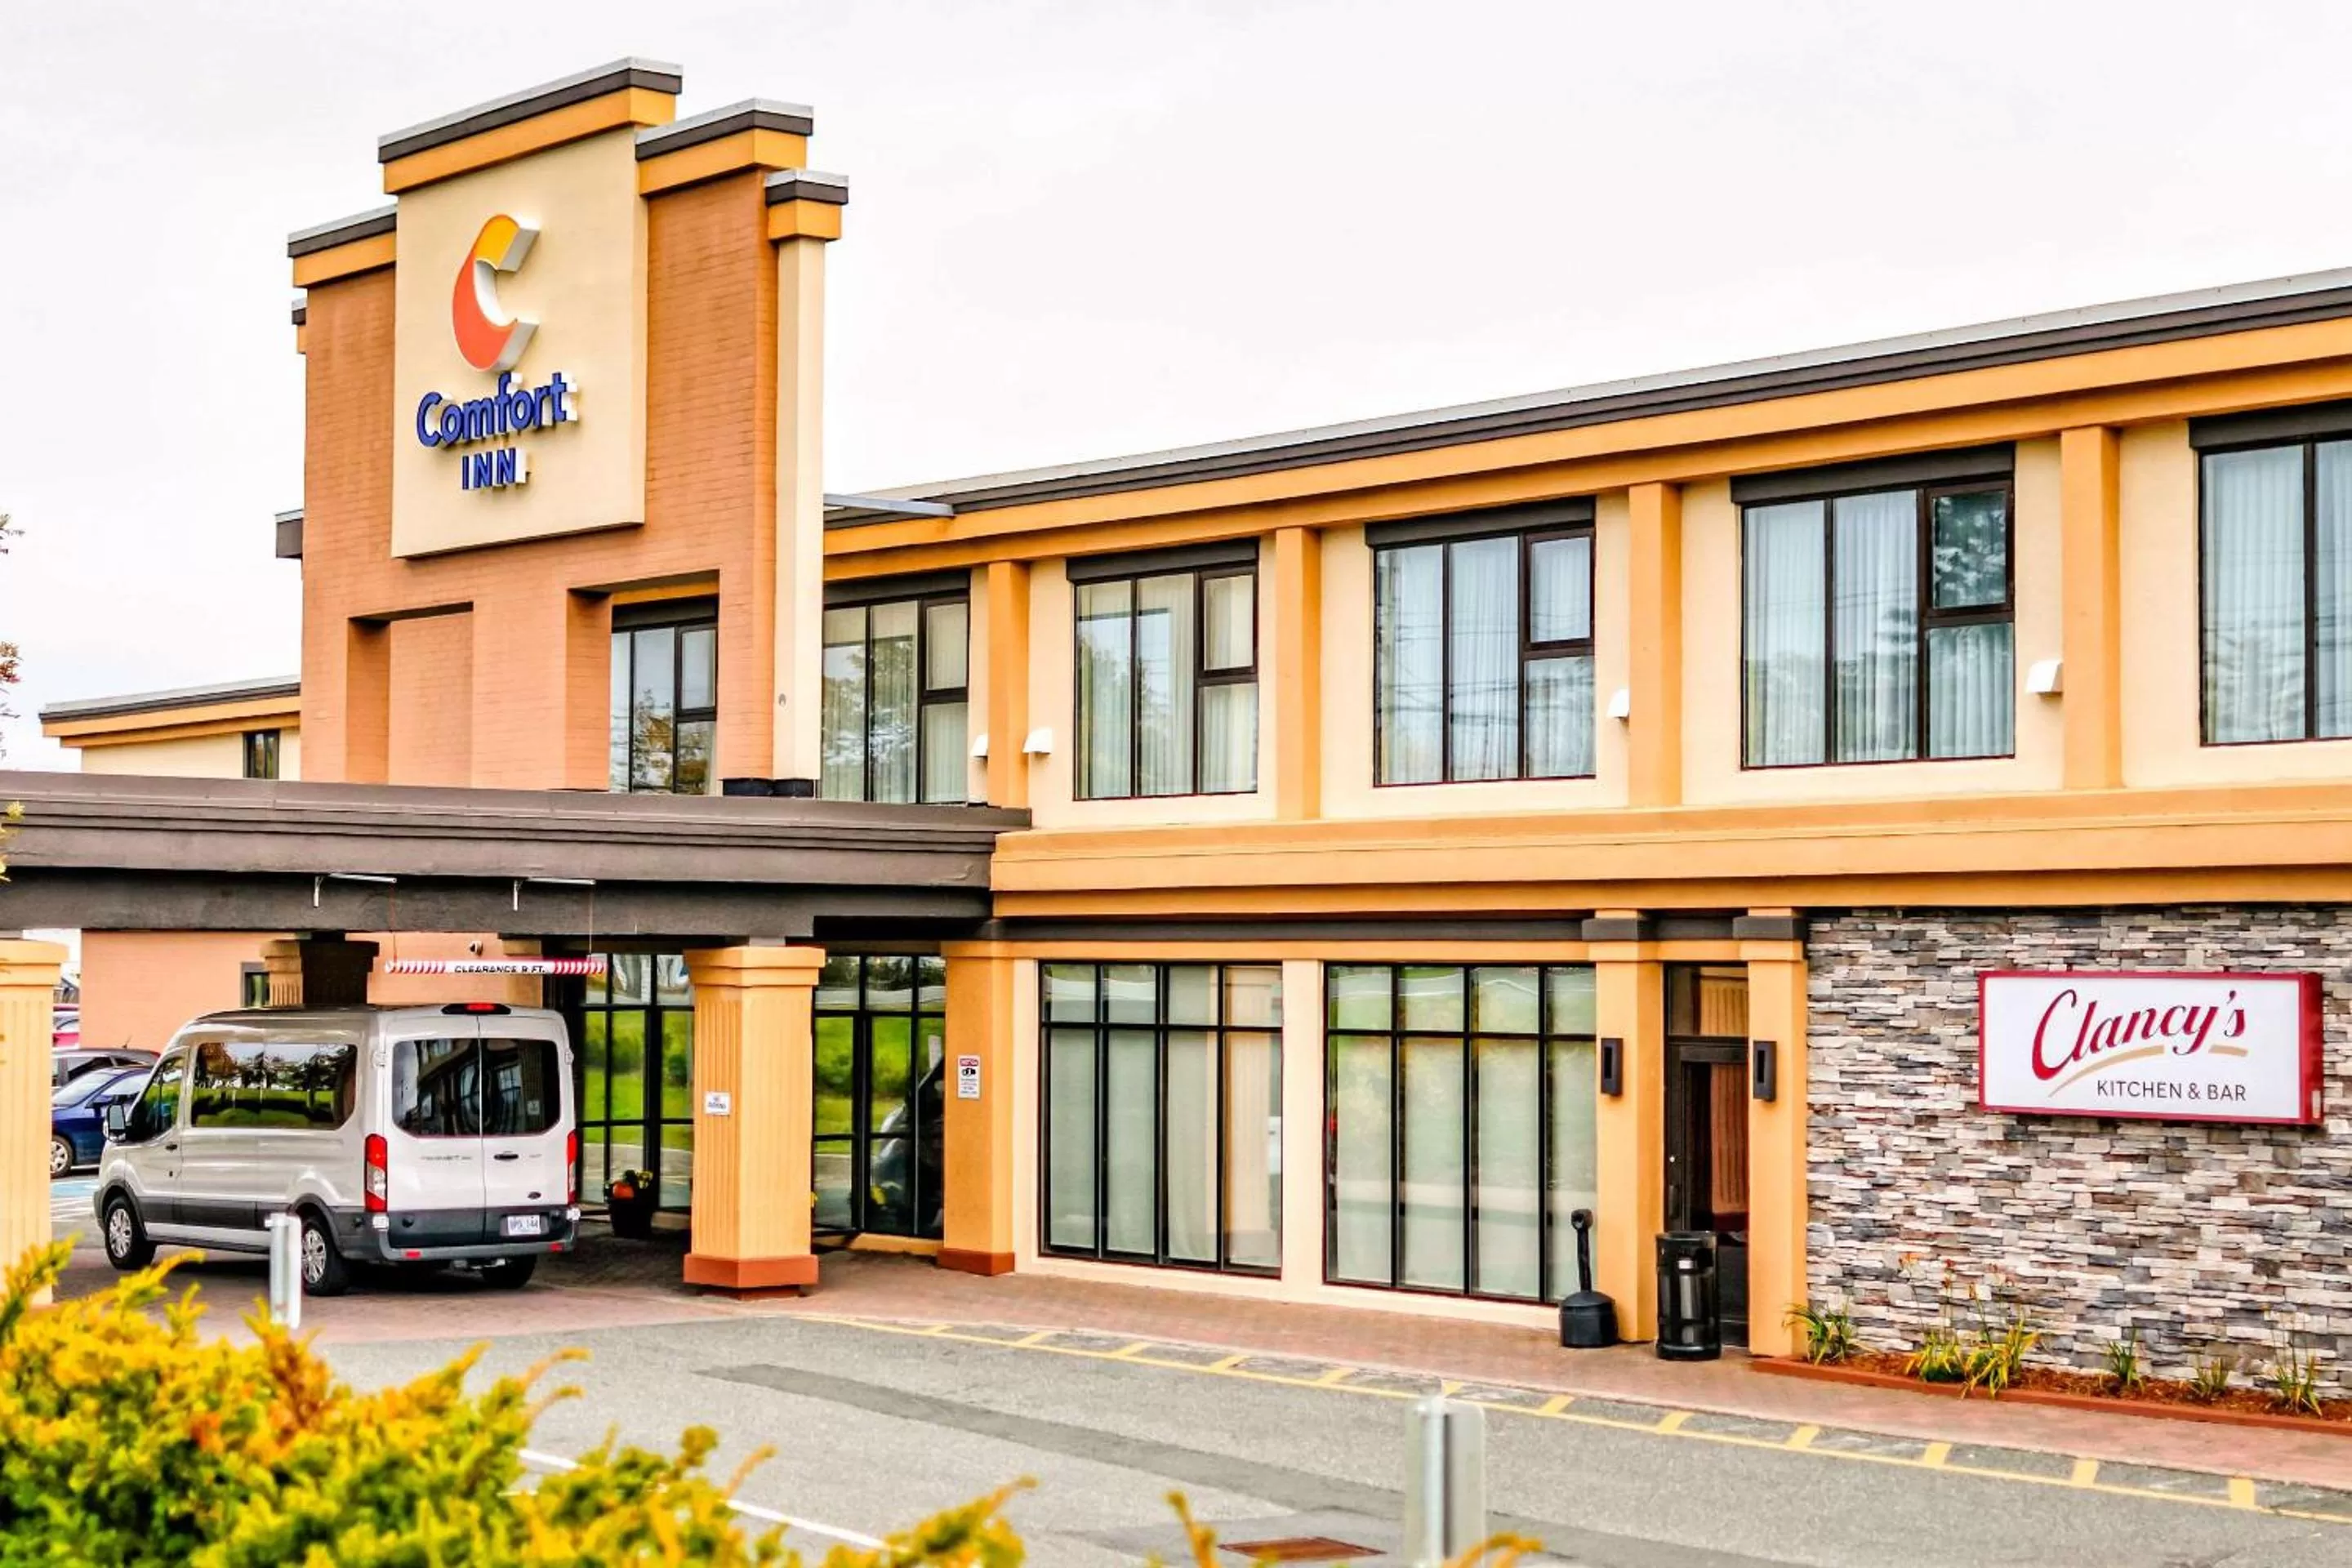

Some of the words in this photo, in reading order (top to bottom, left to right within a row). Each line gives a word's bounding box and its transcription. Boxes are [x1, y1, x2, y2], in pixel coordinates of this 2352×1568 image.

[416, 371, 568, 448] Comfort
[461, 447, 516, 490] INN
[454, 964, 517, 973] CLEARANCE
[2031, 988, 2247, 1081] Clancy's
[2096, 1080, 2182, 1099] KITCHEN
[2188, 1082, 2202, 1100] &
[2207, 1084, 2247, 1101] BAR
